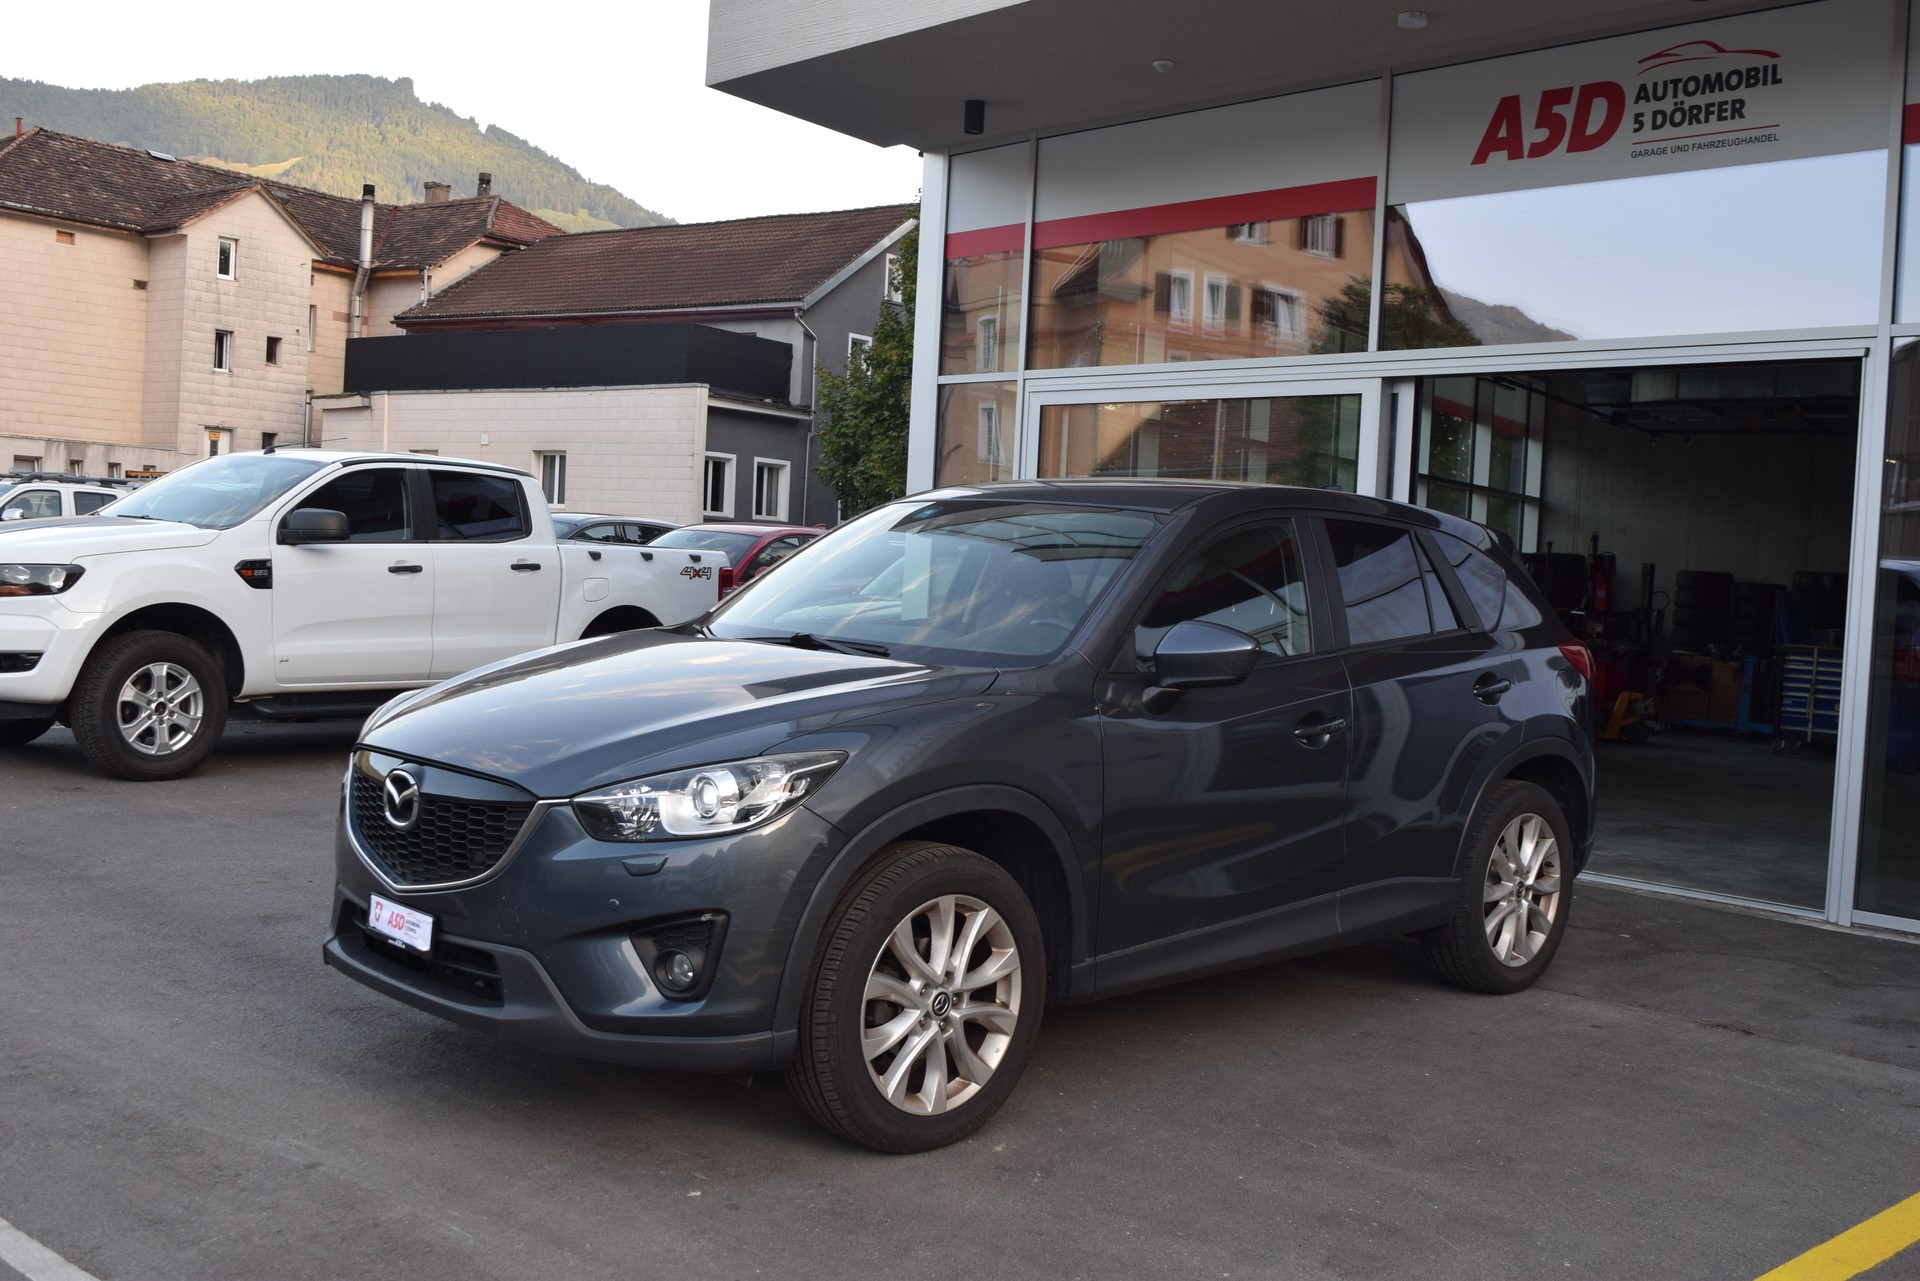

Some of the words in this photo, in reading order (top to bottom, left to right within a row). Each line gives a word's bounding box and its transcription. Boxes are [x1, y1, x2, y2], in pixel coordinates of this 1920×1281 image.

[1633, 64, 1783, 105] AUTOMOBIL
[1470, 81, 1626, 166] A5D
[1632, 111, 1645, 133] 5
[1651, 98, 1746, 131] DÖRFER
[1630, 146, 1668, 159] GARAGE
[1670, 144, 1690, 154] UND
[1691, 133, 1780, 151] FAHRZEUGHANDEL
